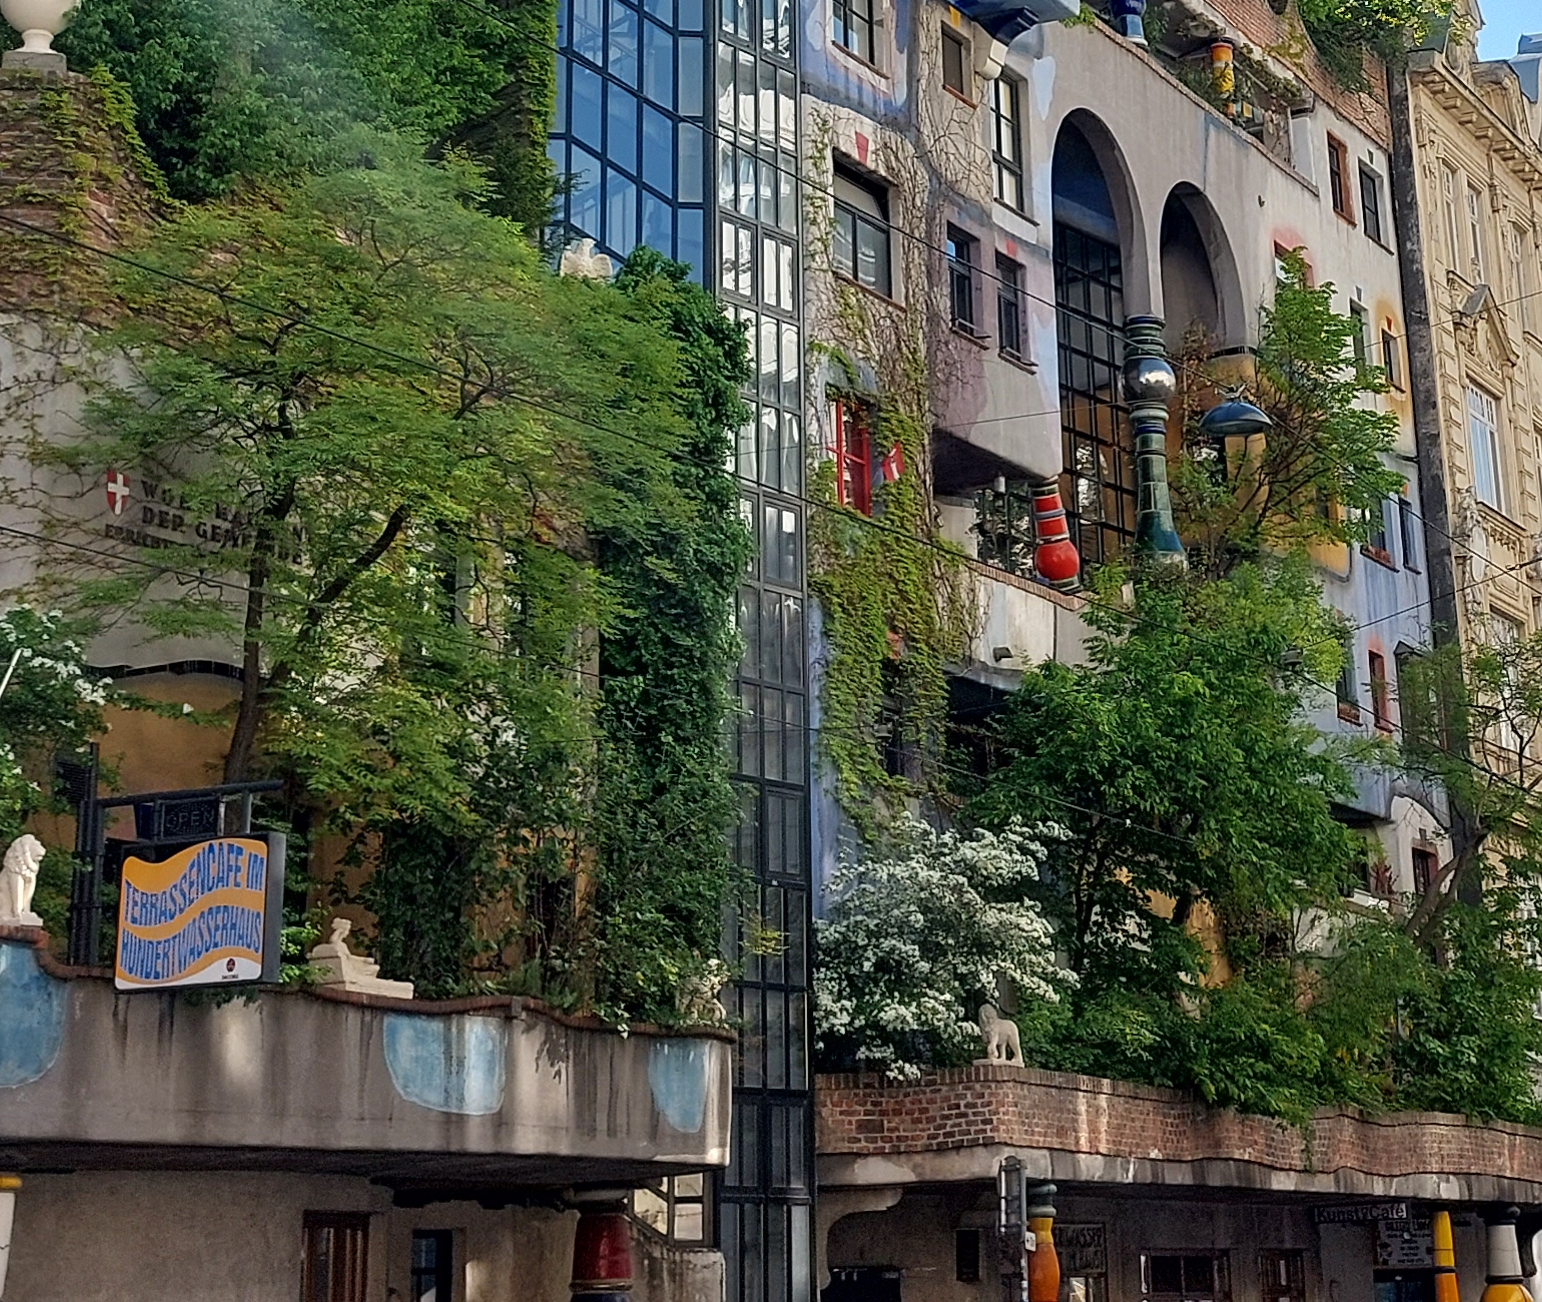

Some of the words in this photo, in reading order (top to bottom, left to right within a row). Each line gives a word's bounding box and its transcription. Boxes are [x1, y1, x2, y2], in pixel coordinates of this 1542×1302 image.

[124, 841, 245, 927] TERRASSENCAFE
[246, 850, 265, 892] IM
[120, 904, 262, 980] HUNDERTWASSERHAUS
